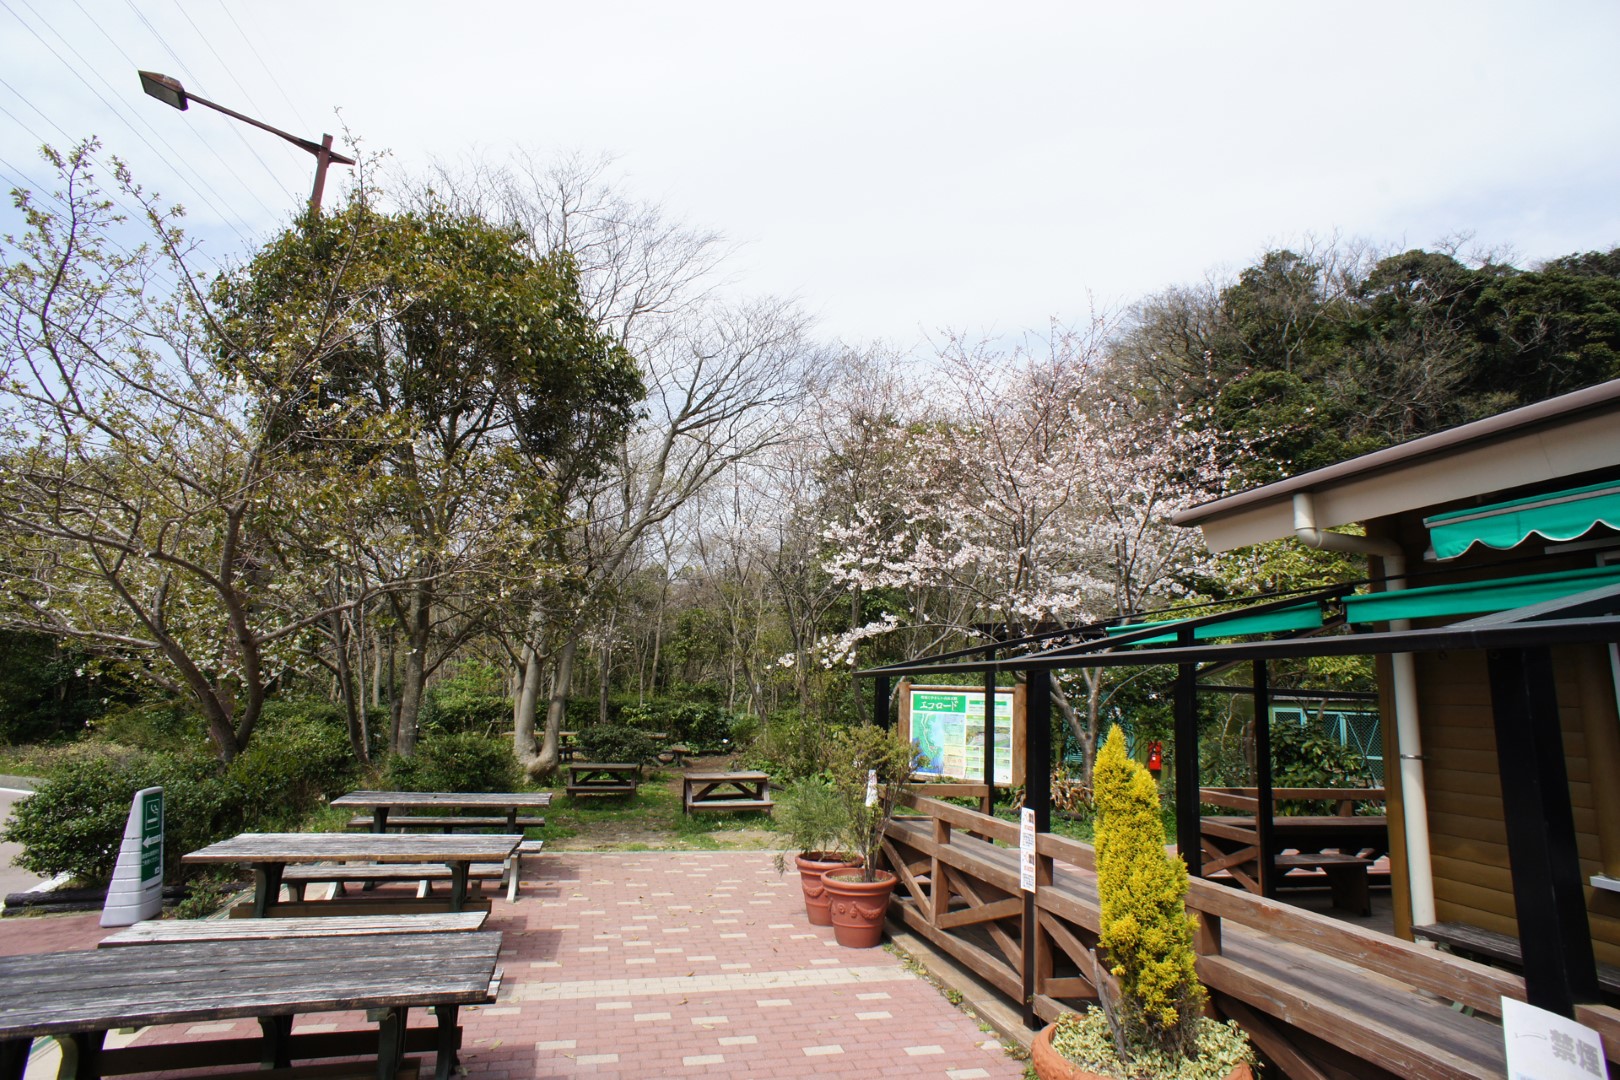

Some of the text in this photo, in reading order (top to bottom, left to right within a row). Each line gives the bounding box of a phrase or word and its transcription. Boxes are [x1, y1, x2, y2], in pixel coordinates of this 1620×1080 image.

[920, 700, 959, 711] エコロード
[1549, 1028, 1603, 1078] 禁煙
